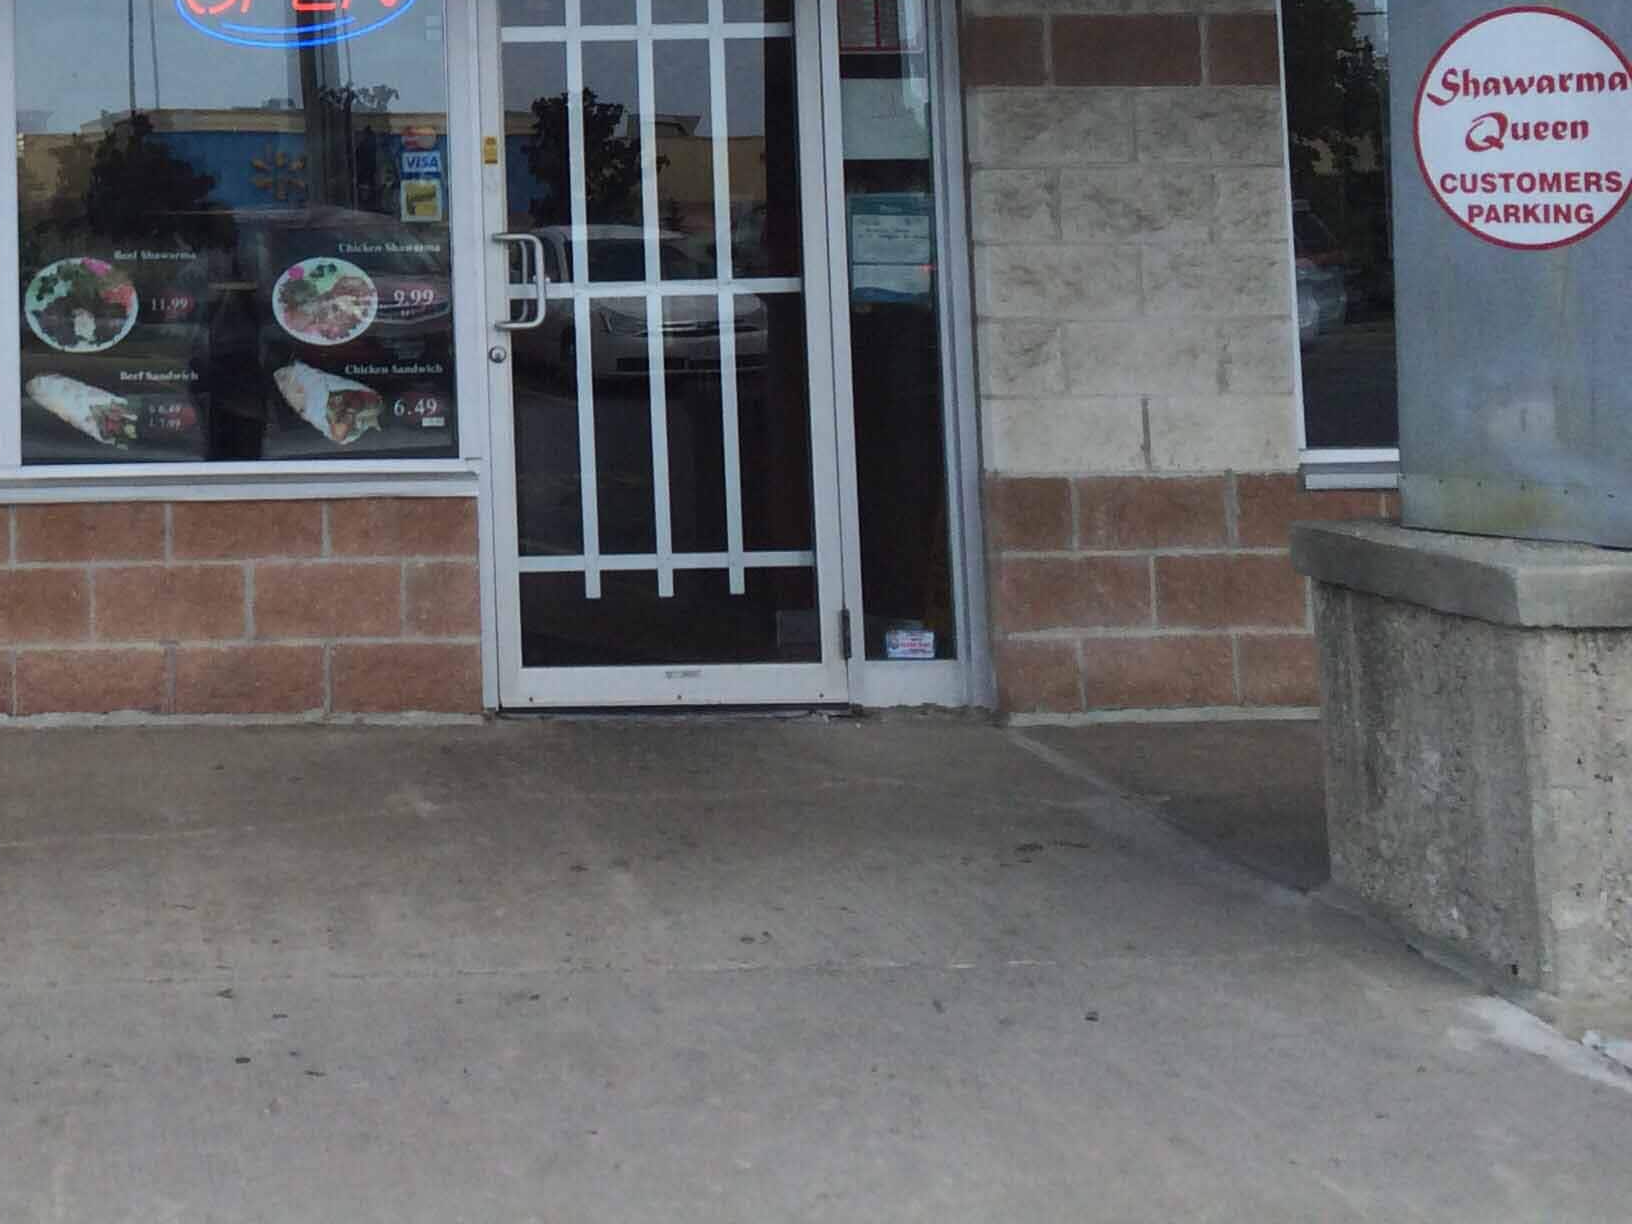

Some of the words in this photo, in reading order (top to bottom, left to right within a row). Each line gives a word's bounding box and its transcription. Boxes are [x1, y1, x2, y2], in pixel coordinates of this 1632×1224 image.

[1426, 68, 1631, 106] Shawarma
[1465, 112, 1590, 152] Queen
[406, 156, 439, 169] VISA
[1440, 171, 1623, 194] CUSTOMERS
[1468, 204, 1594, 224] PARKING
[394, 289, 434, 306] 9.99
[345, 363, 389, 375] Chicken
[391, 363, 444, 374] Sandwich
[394, 398, 437, 416] 6.49
